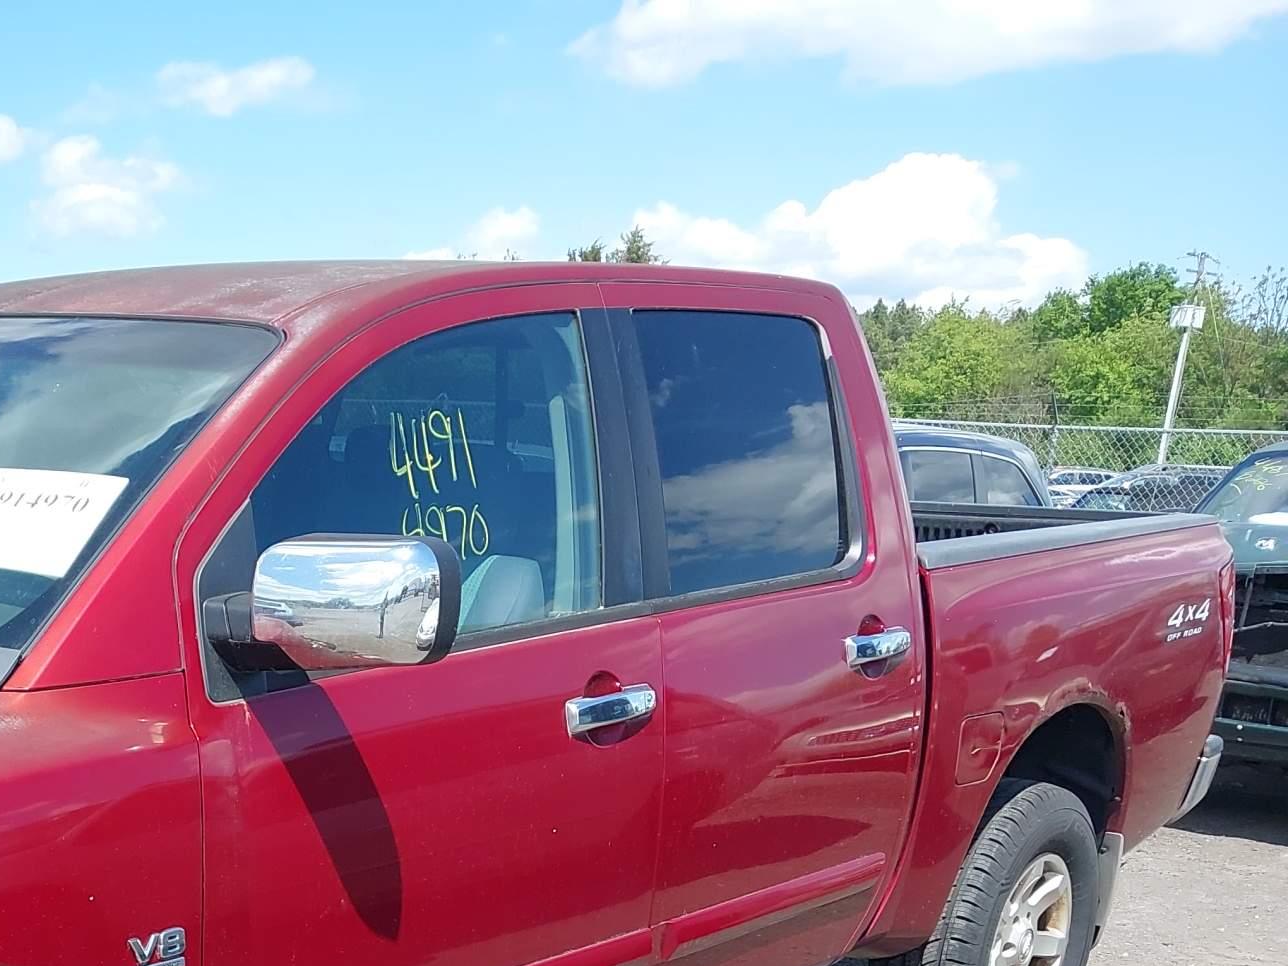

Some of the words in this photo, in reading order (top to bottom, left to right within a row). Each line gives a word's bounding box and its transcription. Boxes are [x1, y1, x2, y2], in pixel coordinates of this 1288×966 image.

[389, 407, 477, 499] 4491
[1166, 631, 1182, 642] OFF
[1182, 626, 1203, 638] ROAD
[127, 926, 186, 964] V8
